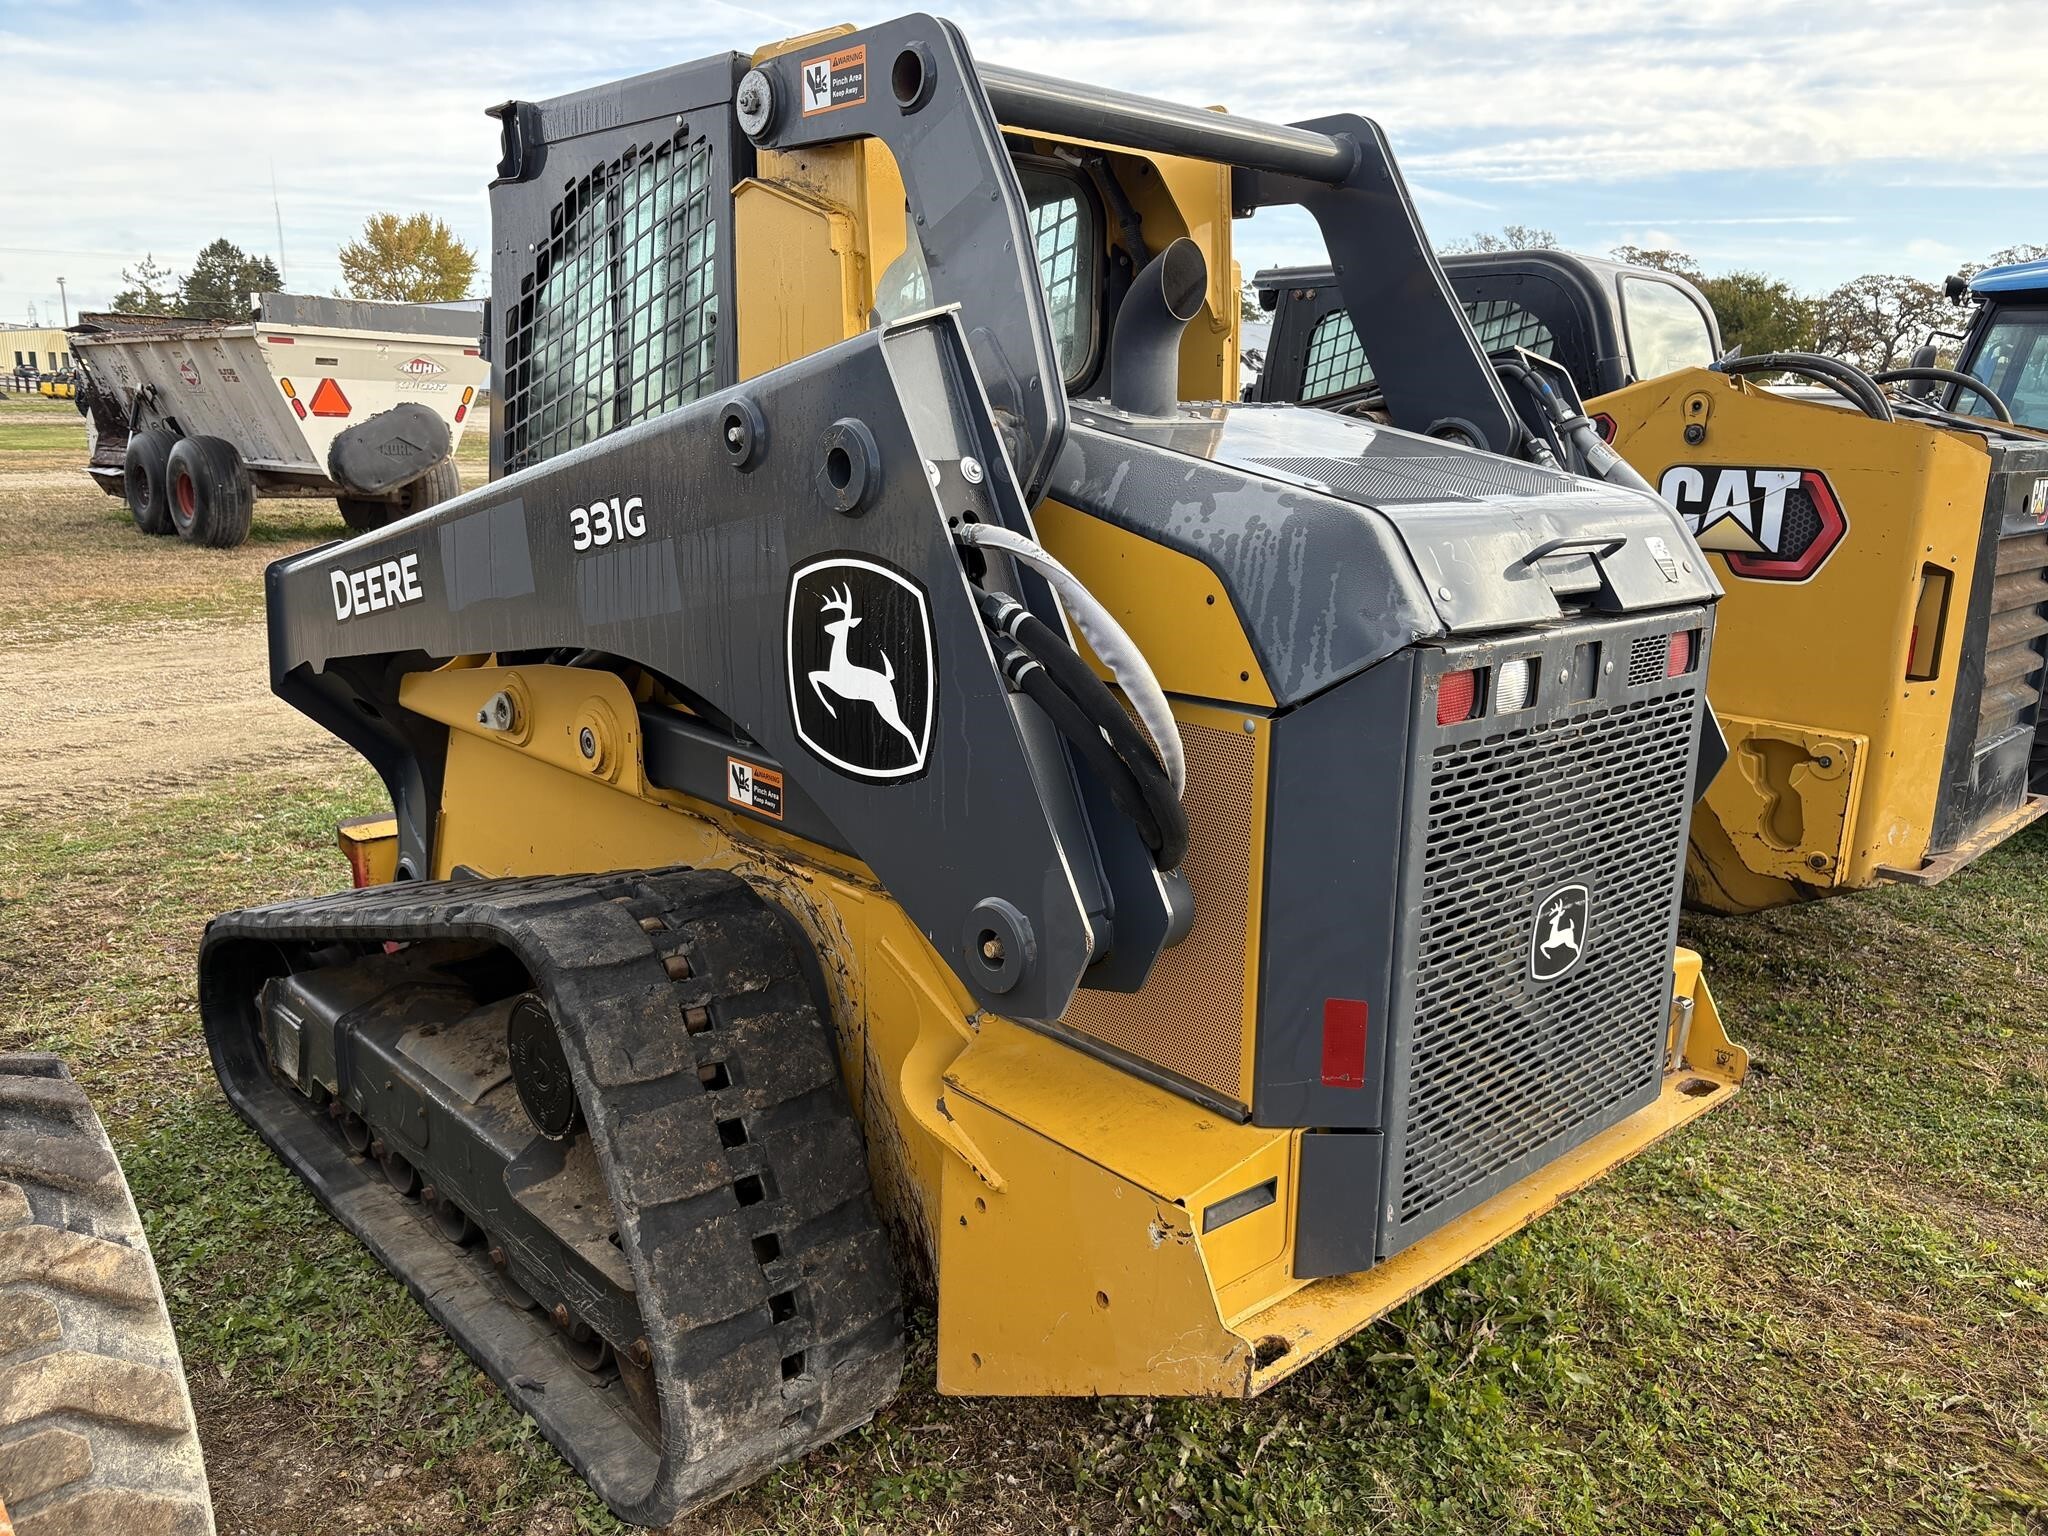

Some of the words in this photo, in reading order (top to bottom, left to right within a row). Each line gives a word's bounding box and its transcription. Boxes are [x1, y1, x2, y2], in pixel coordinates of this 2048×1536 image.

[838, 51, 863, 65] WARNING
[832, 76, 848, 87] Pinch
[849, 73, 862, 82] Area
[832, 90, 845, 98] Keep
[845, 86, 859, 95] Away
[400, 363, 446, 374] KUHN
[1660, 467, 1801, 553] CAT
[570, 497, 647, 551] 331G
[330, 553, 423, 621] DEERE
[757, 770, 780, 784] WARNING
[753, 785, 767, 796] Pinch
[768, 790, 779, 800] Area
[753, 795, 764, 804] Keep
[765, 799, 776, 809] Away
